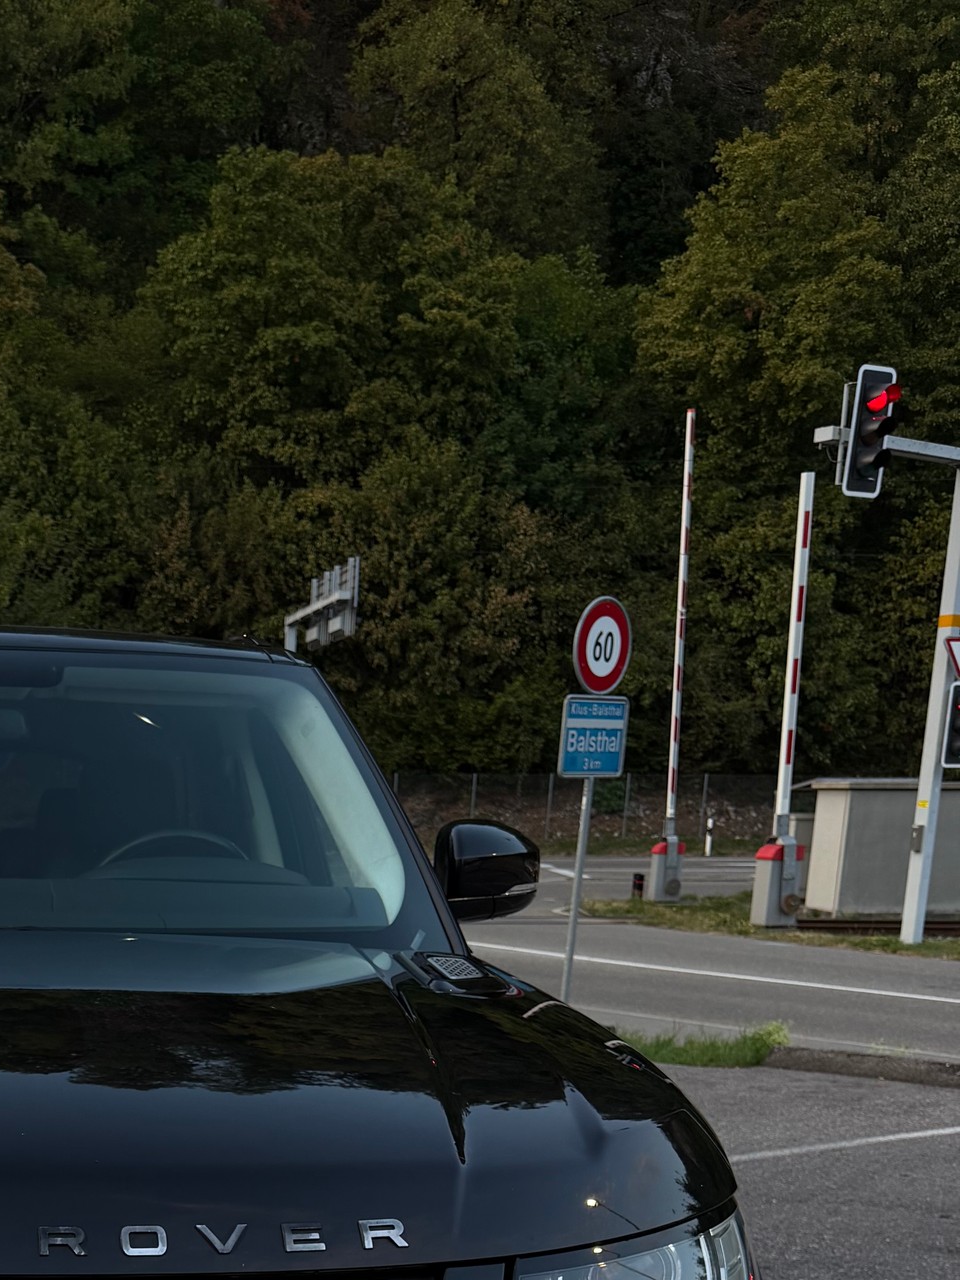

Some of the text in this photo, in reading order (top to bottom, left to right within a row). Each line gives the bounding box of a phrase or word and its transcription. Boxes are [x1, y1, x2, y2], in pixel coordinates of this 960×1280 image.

[593, 631, 614, 663] 60
[566, 729, 621, 753] Balsthal
[582, 757, 602, 771] 3 km
[38, 1218, 410, 1257] ROVER
